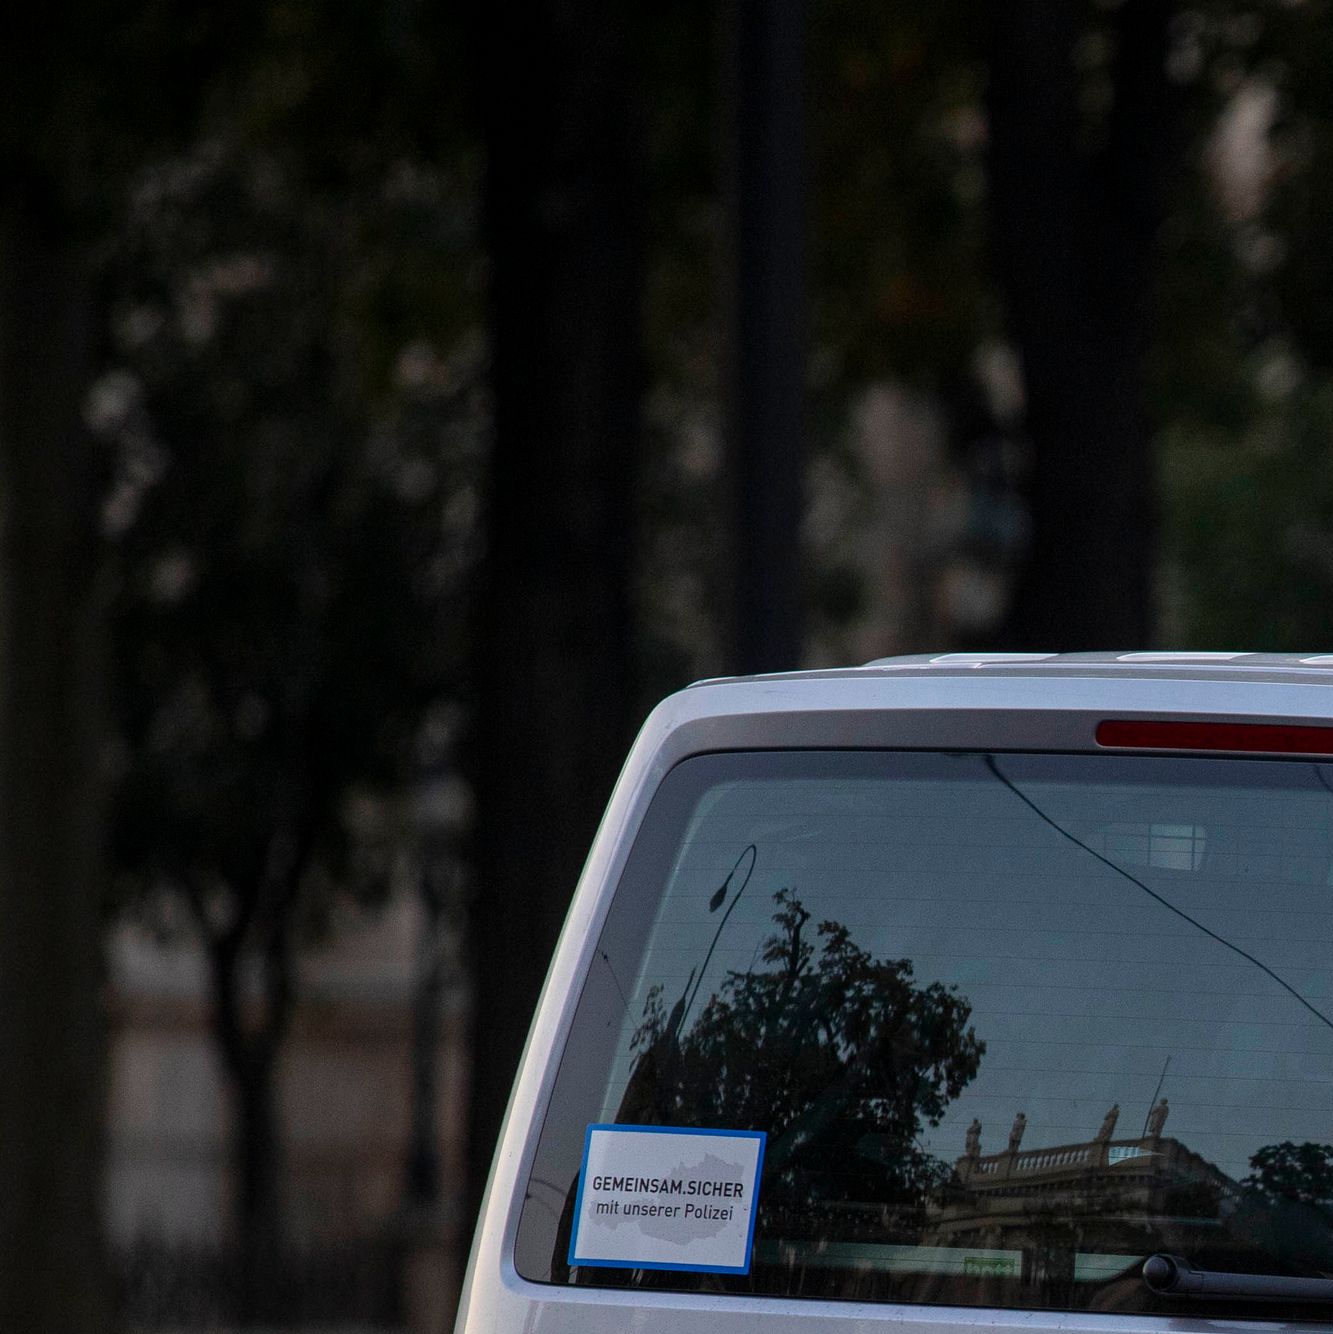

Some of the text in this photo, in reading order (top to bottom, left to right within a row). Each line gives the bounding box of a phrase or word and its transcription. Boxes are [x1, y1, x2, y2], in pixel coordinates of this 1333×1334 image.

[592, 1176, 744, 1198] GEMEINSAM.SICHER
[596, 1200, 734, 1221] mit unserer Polizei
